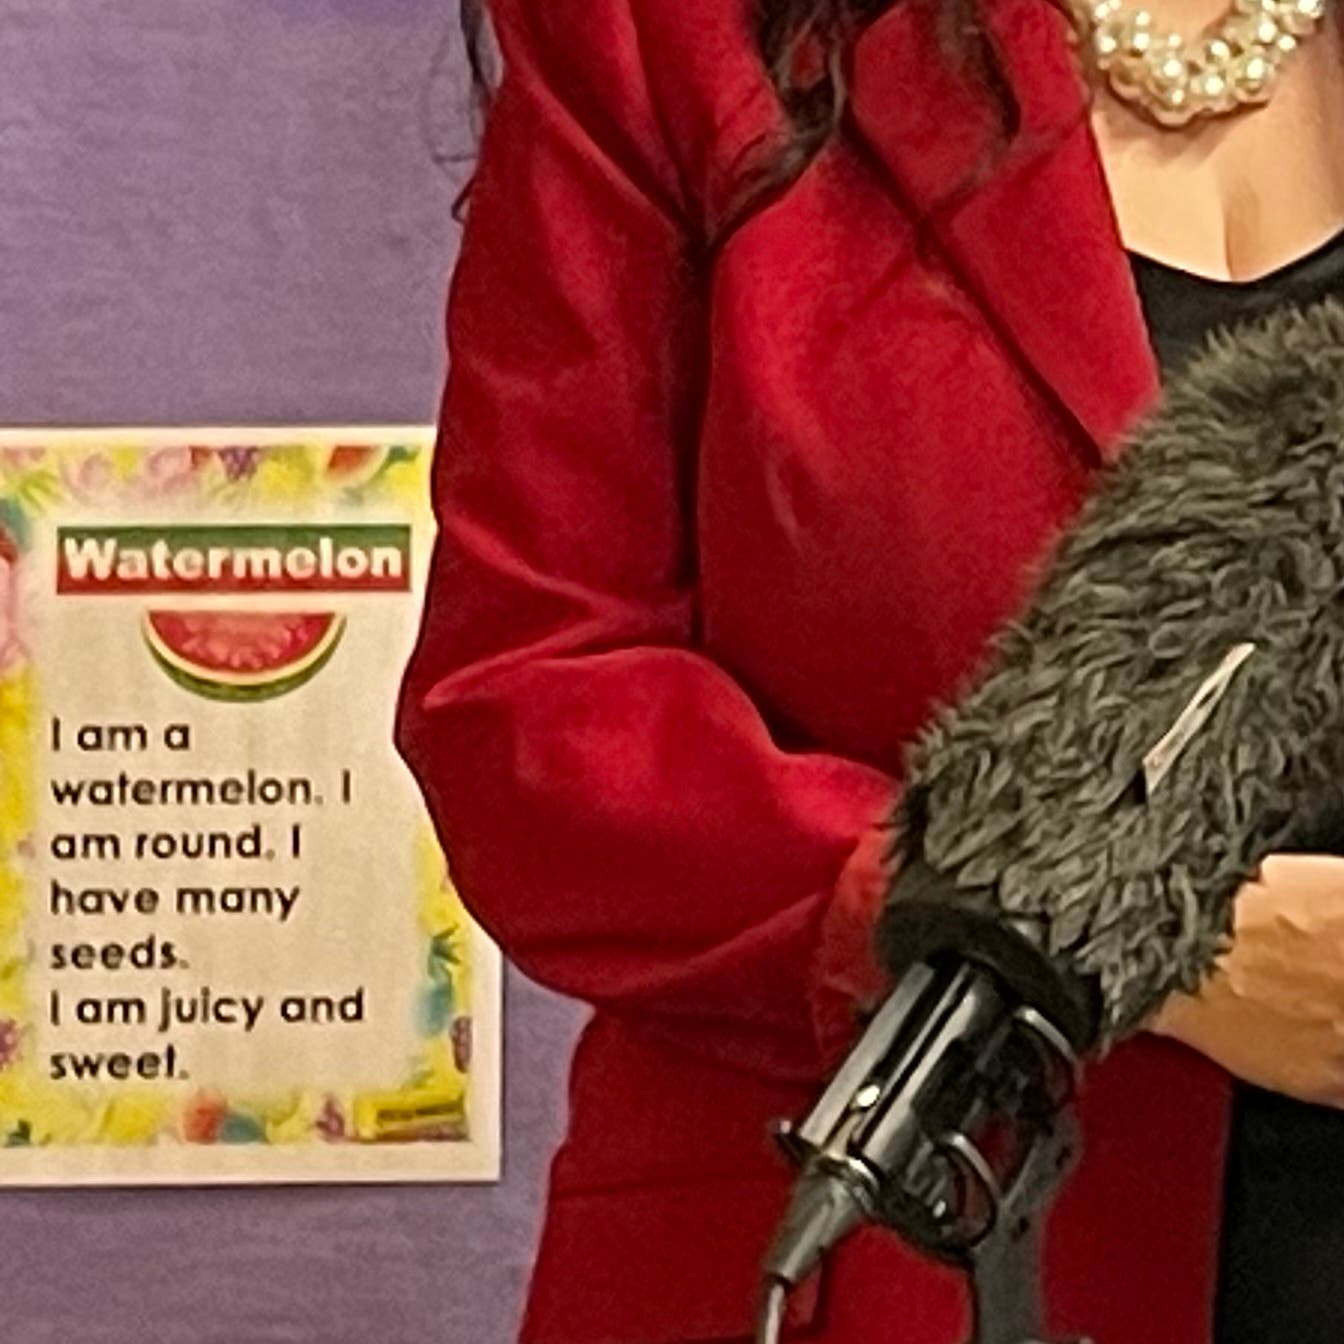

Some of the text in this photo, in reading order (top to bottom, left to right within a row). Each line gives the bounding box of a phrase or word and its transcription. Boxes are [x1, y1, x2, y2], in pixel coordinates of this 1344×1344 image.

[63, 536, 403, 580] Watermelon
[51, 717, 190, 752] I am a
[51, 769, 351, 806] watermelon. I
[50, 824, 301, 860] am round. I
[51, 880, 301, 921] have many
[51, 935, 189, 970] seeds.
[50, 987, 365, 1033] I am juicy and
[50, 1044, 189, 1080] sweet.
